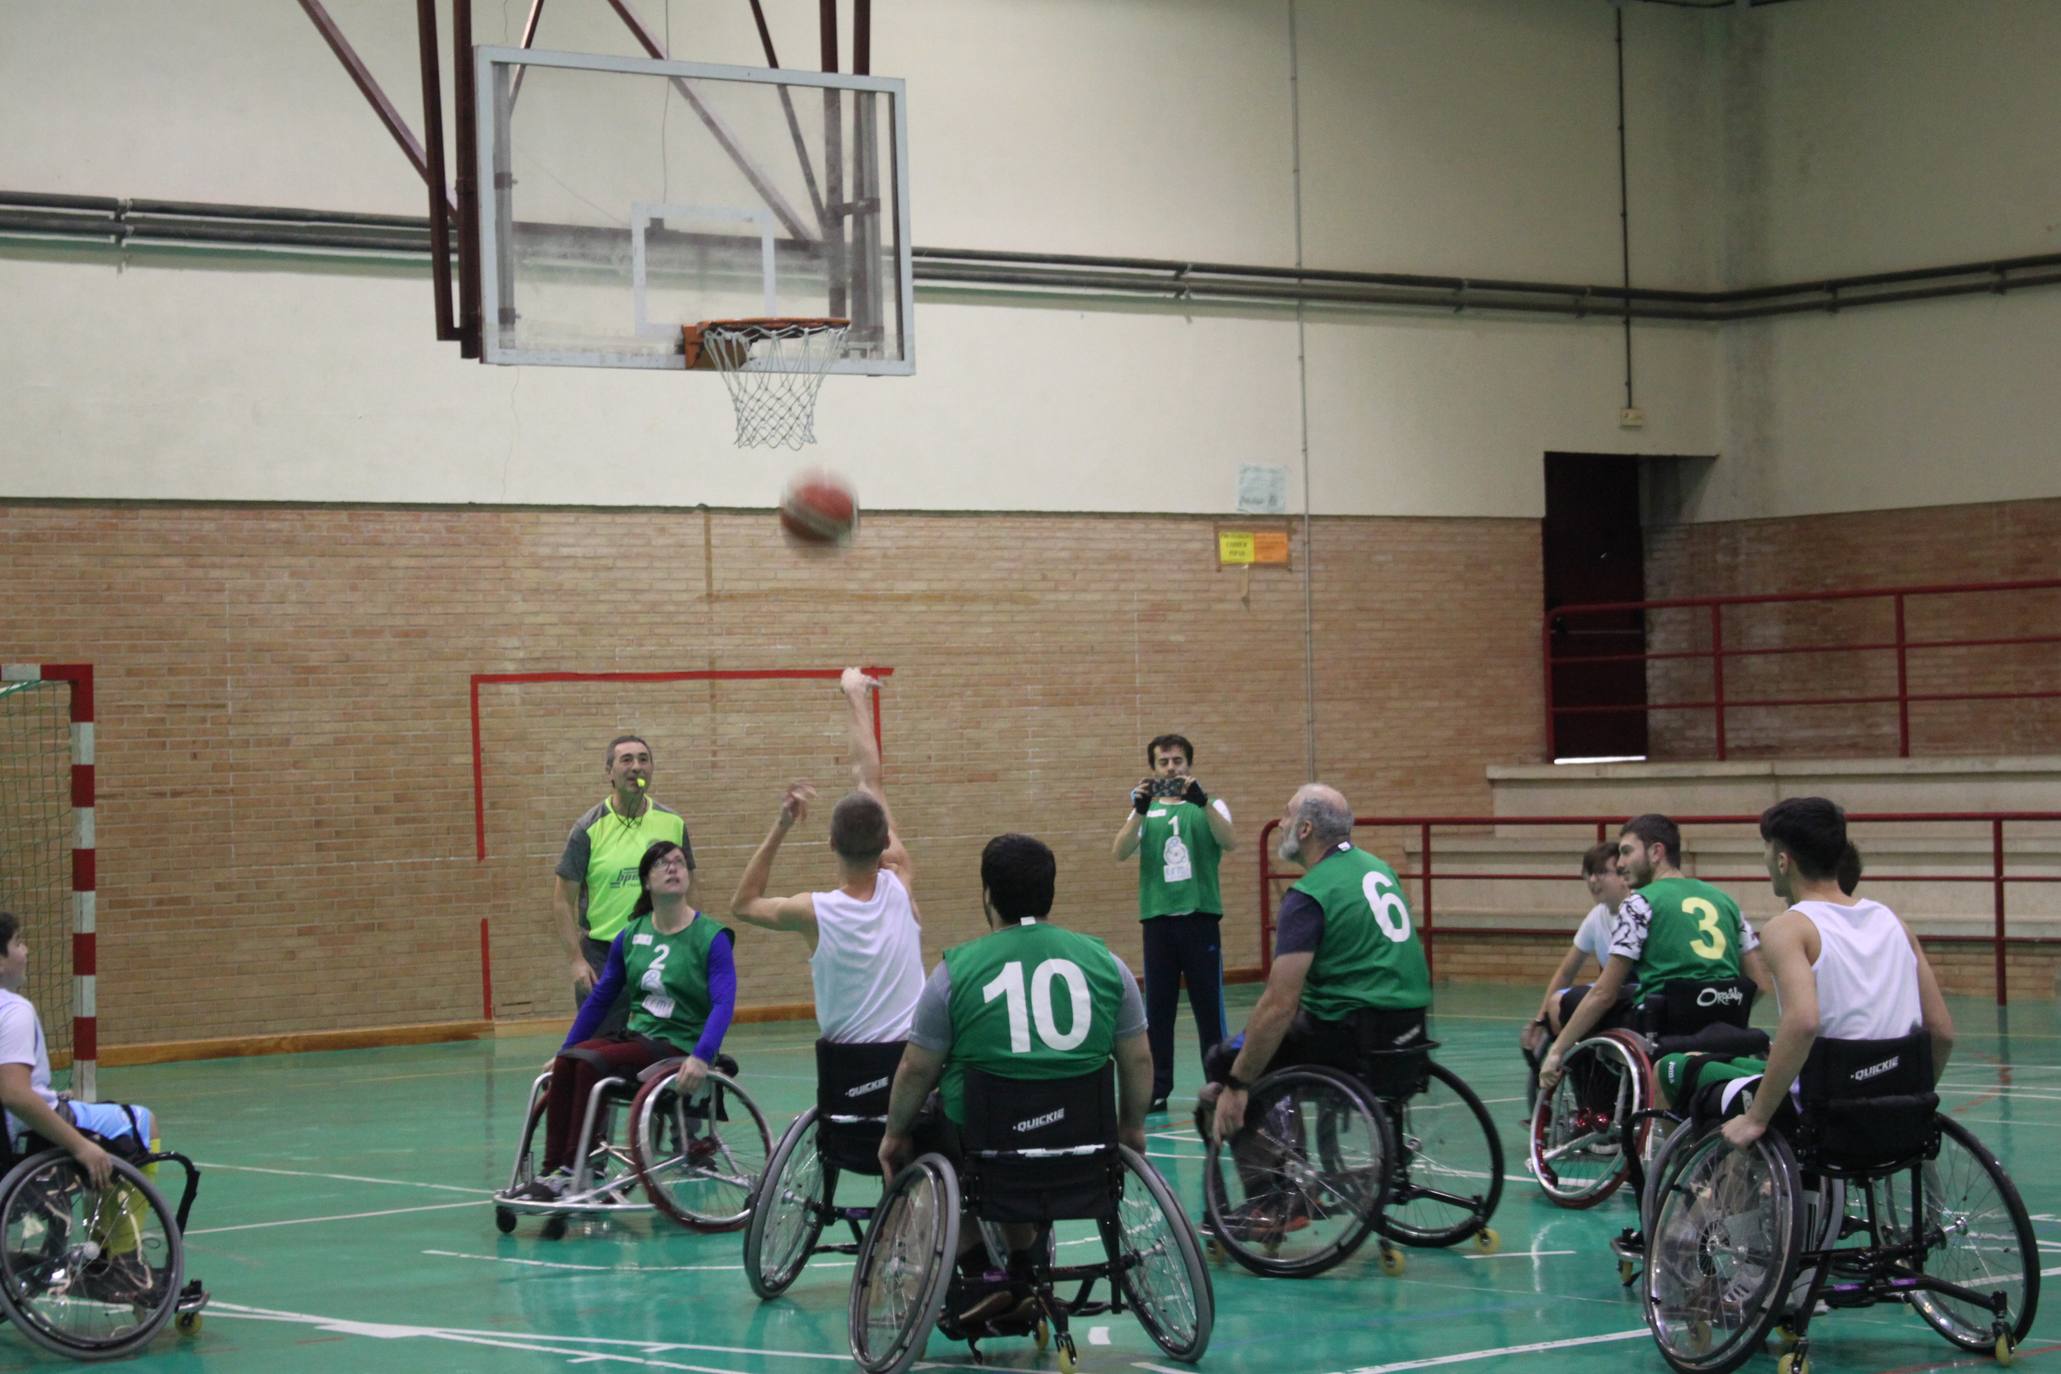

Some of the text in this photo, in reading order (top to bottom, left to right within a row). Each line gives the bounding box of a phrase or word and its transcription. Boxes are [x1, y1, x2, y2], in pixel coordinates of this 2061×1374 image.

[1168, 815, 1179, 836] 1
[1362, 871, 1410, 942] 6
[1682, 897, 1726, 959] 3
[648, 944, 670, 970] 2
[983, 958, 1091, 1053] 10
[1016, 1107, 1065, 1132] QUICKIE
